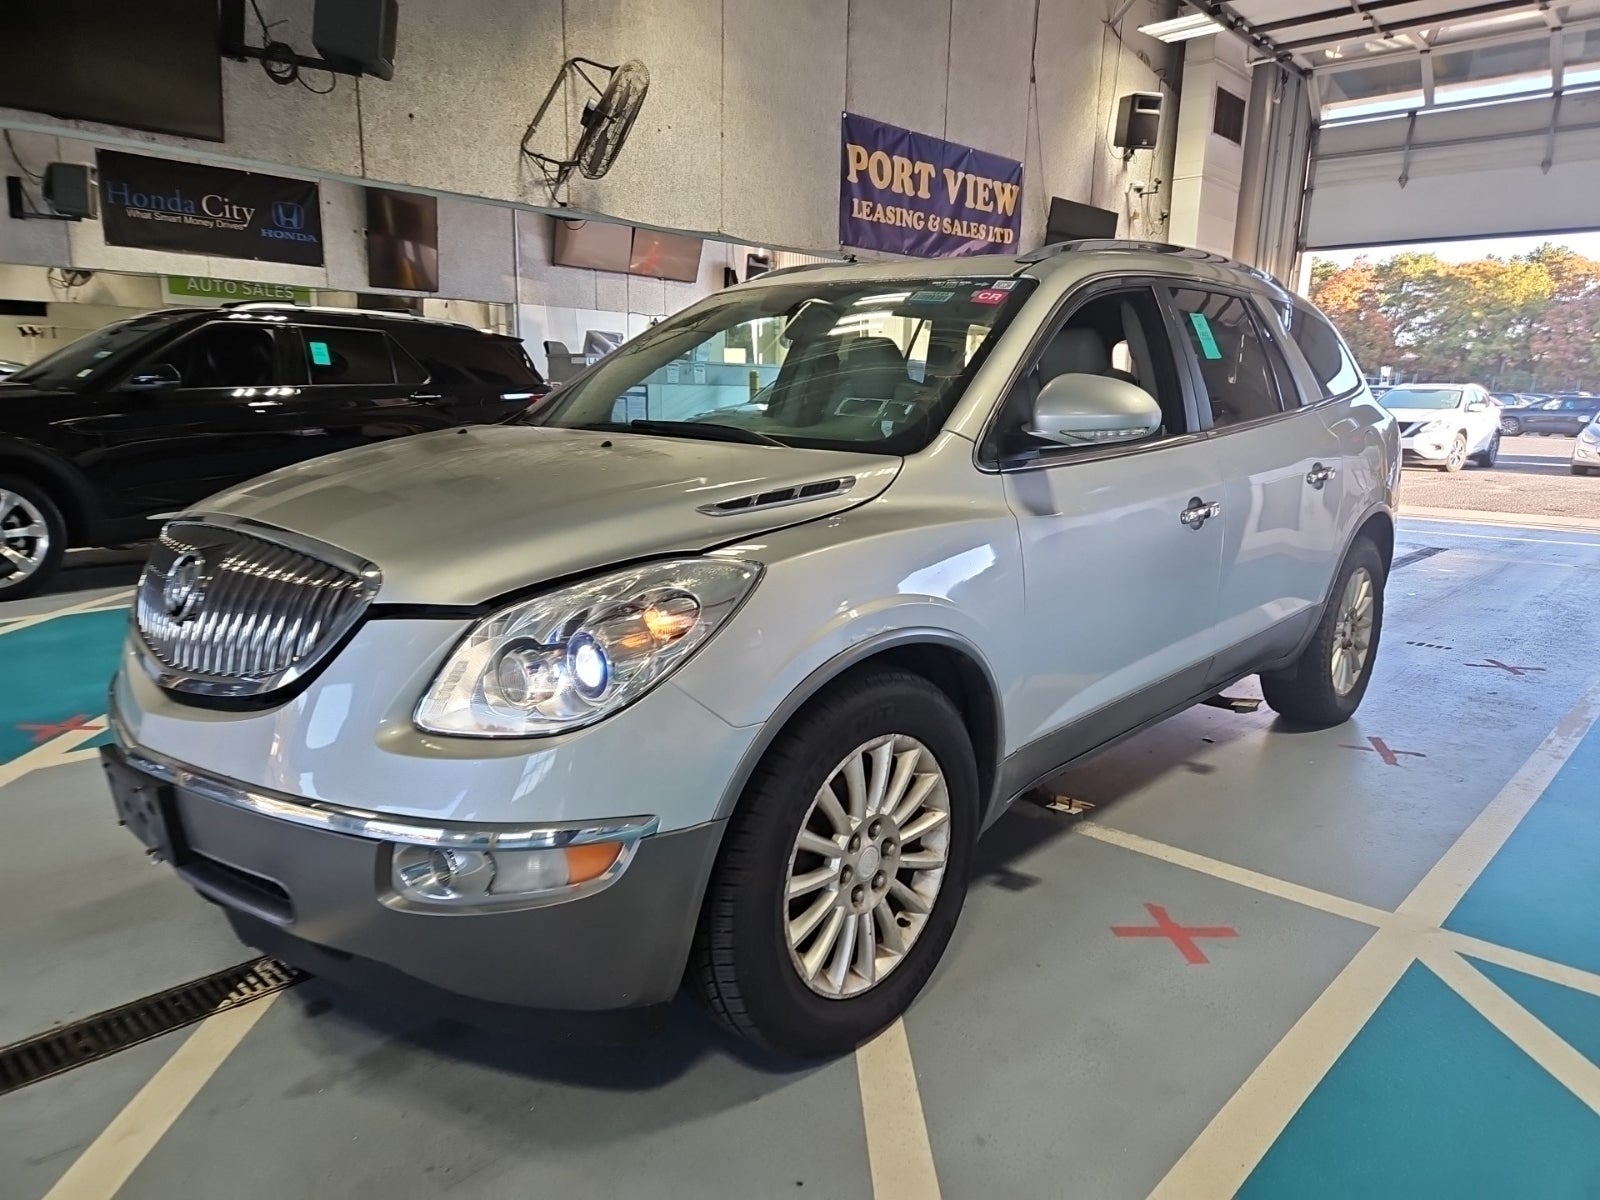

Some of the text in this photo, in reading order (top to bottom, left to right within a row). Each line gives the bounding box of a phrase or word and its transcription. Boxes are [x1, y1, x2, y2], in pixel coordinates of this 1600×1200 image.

[846, 143, 1020, 218] PORT VIEW
[105, 181, 256, 228] Honda City
[126, 208, 153, 220] What
[153, 212, 182, 223] Smart
[183, 216, 214, 228] Money
[851, 198, 1014, 244] LEASING & SALES LTD
[260, 228, 319, 243] HONDA
[186, 277, 295, 299] AUTO SALES
